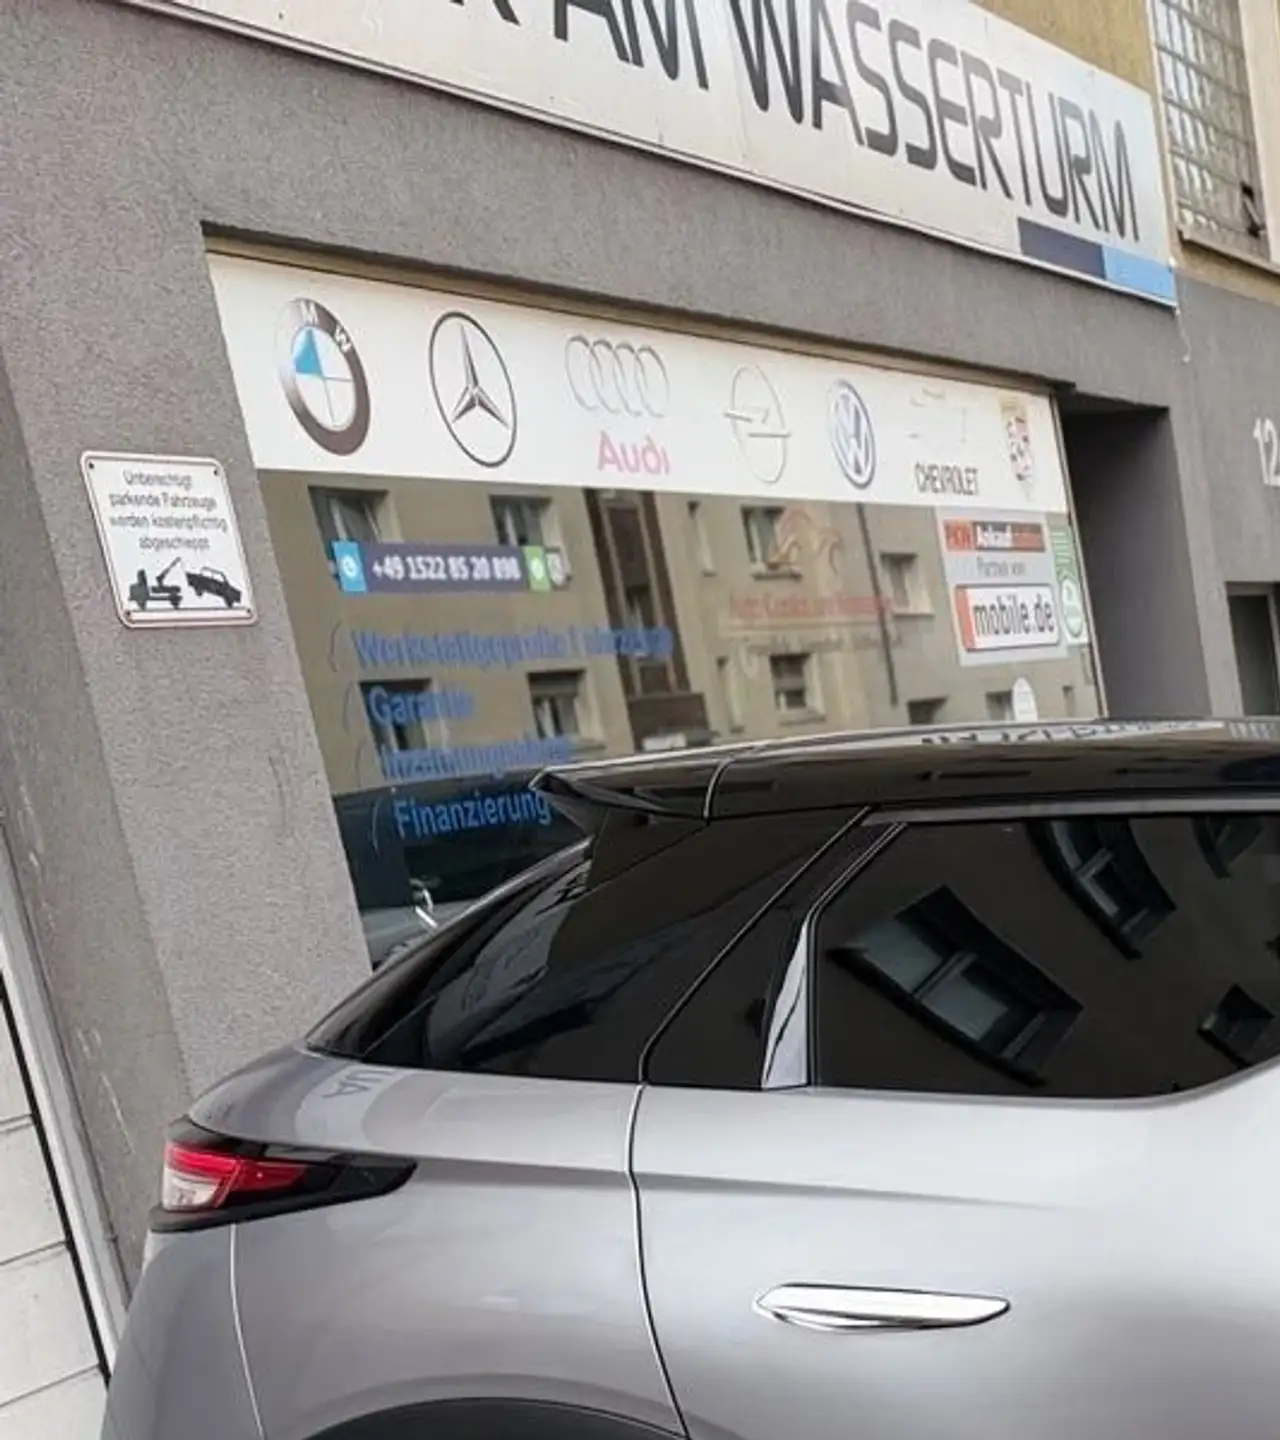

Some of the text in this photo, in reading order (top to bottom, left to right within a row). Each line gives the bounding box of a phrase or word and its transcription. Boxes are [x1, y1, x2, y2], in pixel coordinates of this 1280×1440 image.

[728, 0, 1141, 243] WASSERTURM
[597, 430, 670, 476] Audi
[914, 462, 979, 496] CHEVROLET
[372, 555, 405, 581] +49
[406, 555, 448, 581] 1522
[973, 593, 1055, 640] mobile.de
[394, 789, 552, 838] Finanzierung
